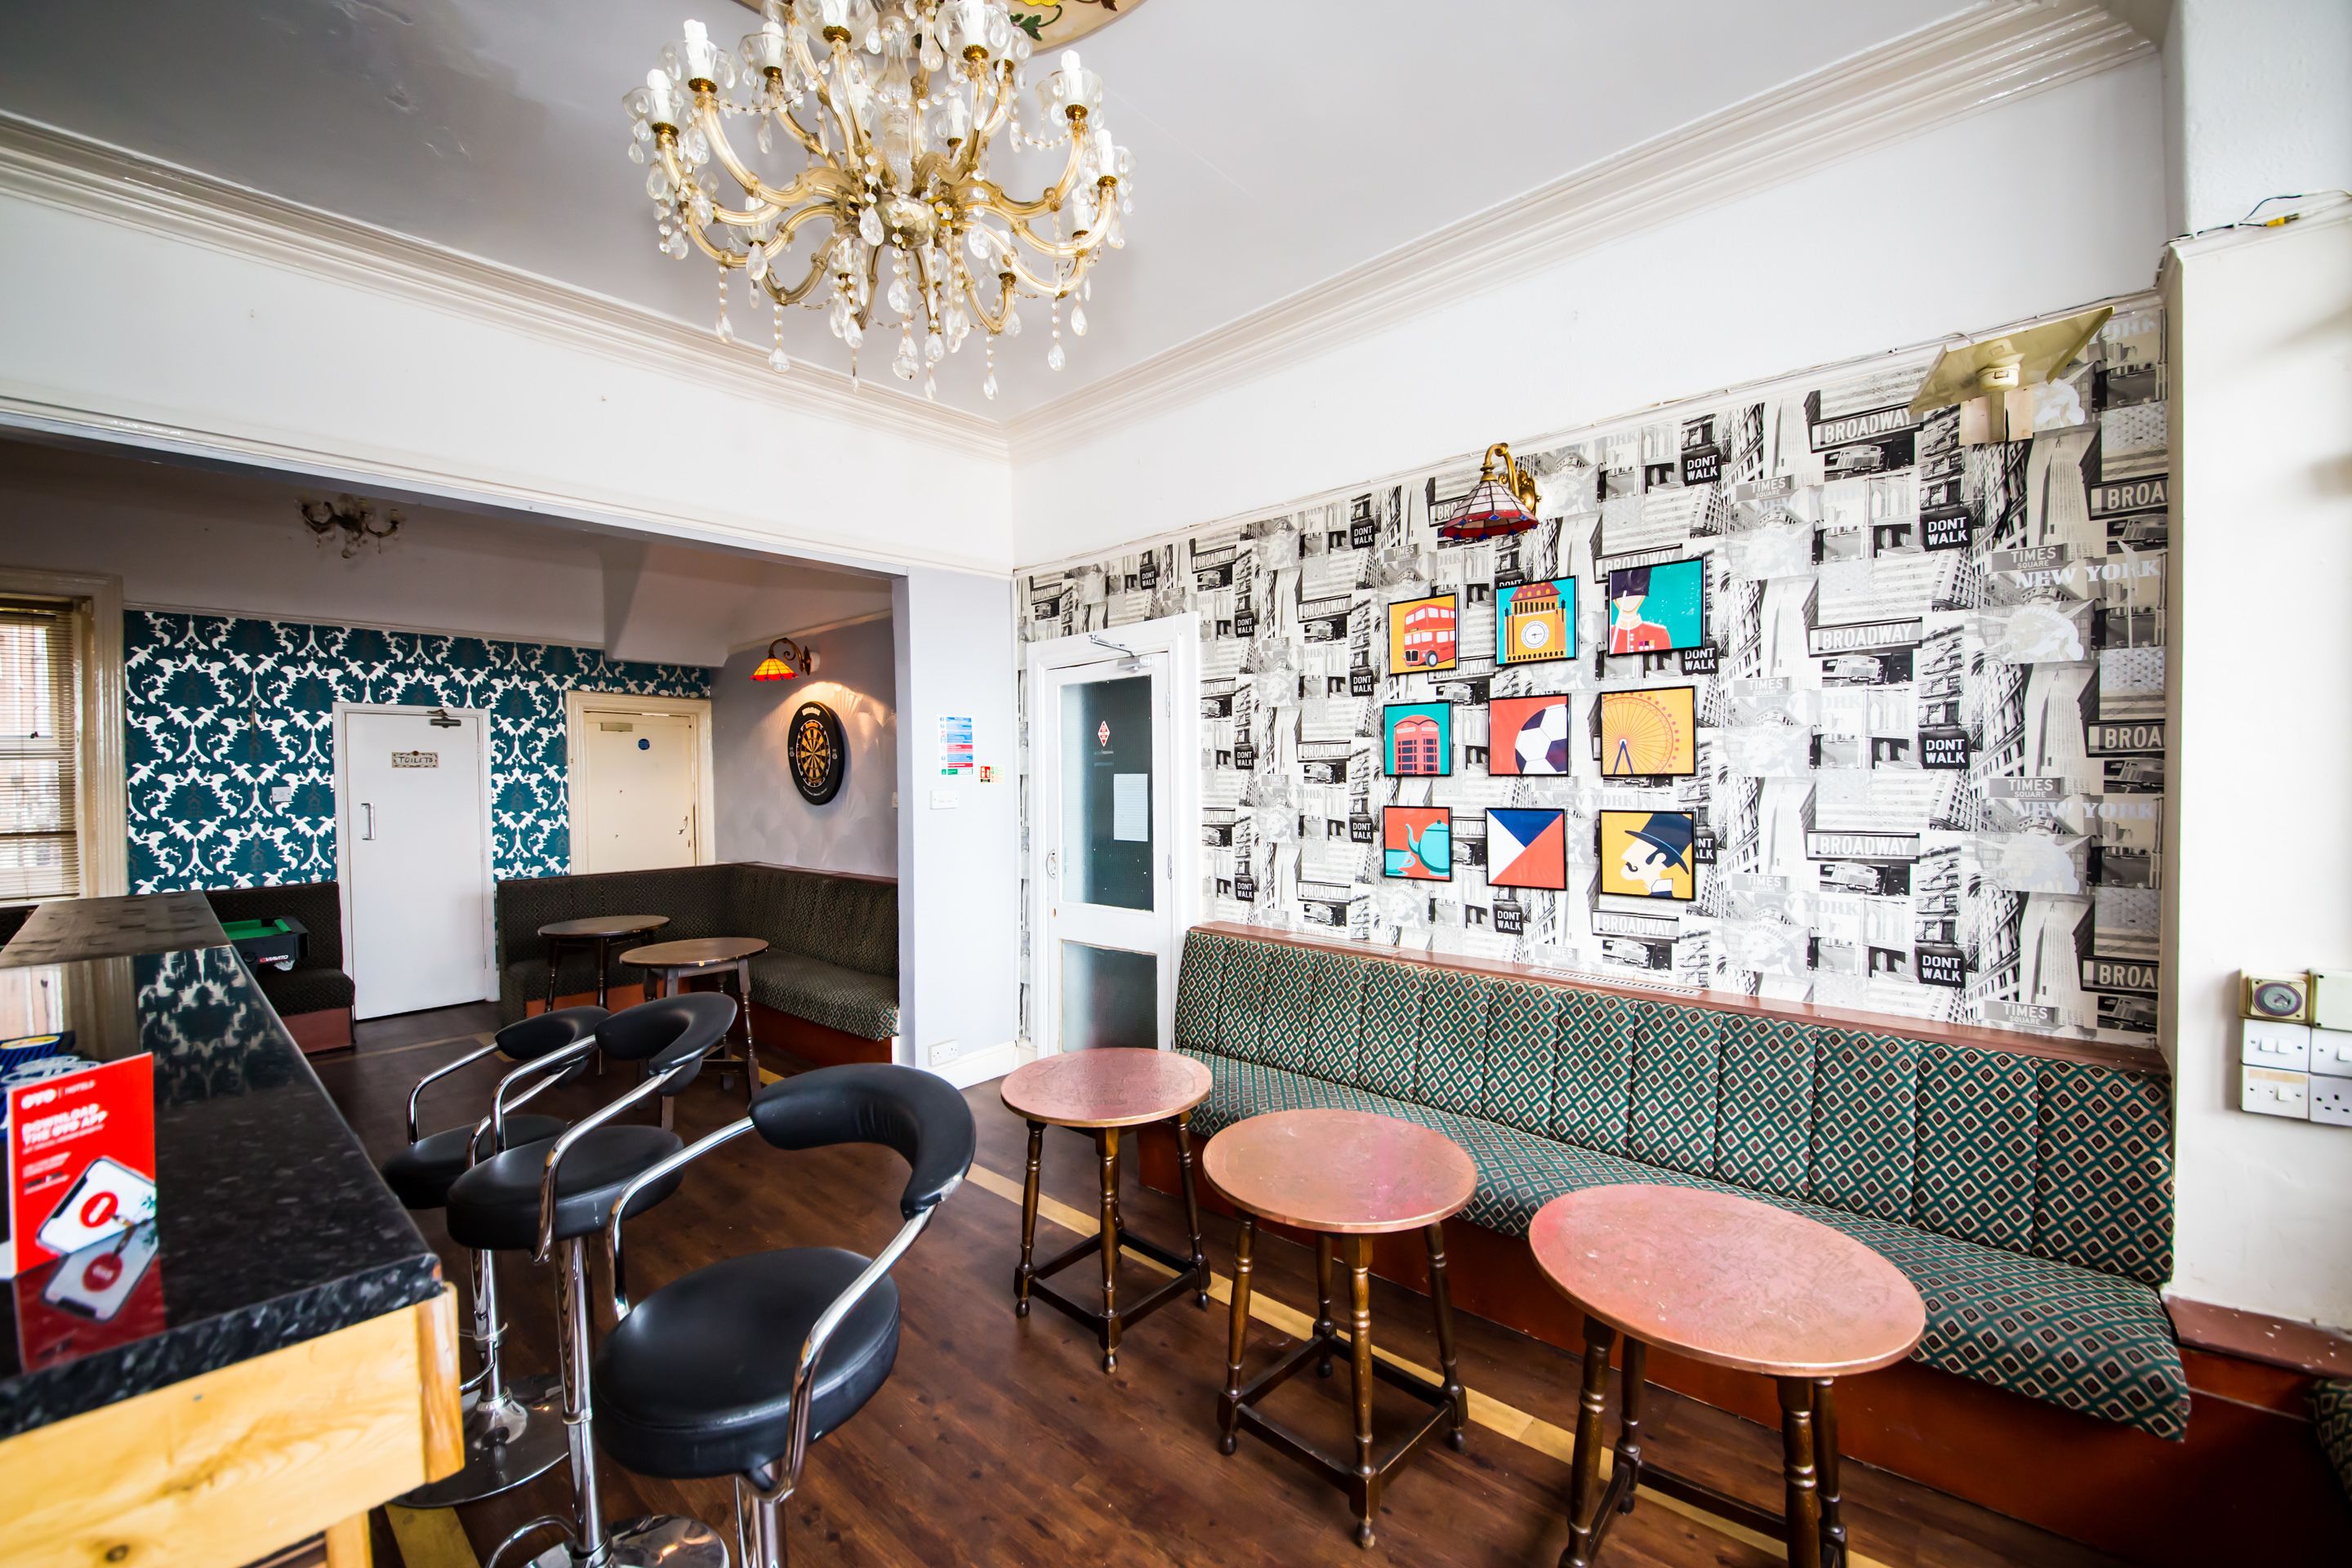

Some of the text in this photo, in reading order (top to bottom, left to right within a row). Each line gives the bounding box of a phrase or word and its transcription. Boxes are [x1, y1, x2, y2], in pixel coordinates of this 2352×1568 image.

[1824, 408, 1912, 443] BROADWAY
[1686, 454, 1717, 471] DONT
[1686, 466, 1718, 482] WALK
[1750, 477, 1786, 493] TIMES
[1756, 489, 1780, 499] SQUARE
[2107, 480, 2167, 510] BROA
[1927, 517, 1967, 532] DONT
[1354, 526, 1373, 537] DONT
[1927, 529, 1968, 546] WALK
[1354, 535, 1374, 546] WALK
[1392, 545, 1415, 558] TIMES
[2011, 547, 2056, 564] TIMES
[1196, 548, 1233, 568] BROADWAY
[1605, 549, 1676, 572] BROADWAY
[2017, 559, 2049, 569] SQUARE
[1142, 572, 1154, 580] DONT
[2015, 559, 2161, 589] NEW YORK
[1142, 577, 1156, 586] WALK
[1304, 598, 1348, 618] BROADWAY
[1237, 617, 1253, 627] DONT
[1237, 625, 1254, 635] WALK
[1268, 638, 1286, 647] TIMES
[1822, 623, 1913, 650] BROADWAY
[1685, 648, 1715, 660] DONT
[1685, 659, 1716, 670] WALK
[1353, 675, 1371, 684] DONT
[1748, 679, 1784, 690] TIMES
[1200, 681, 1232, 696] ROADWAY
[1353, 683, 1372, 693] WALK
[2105, 726, 2163, 749] BROA
[1926, 739, 1965, 751] DONT
[1236, 751, 1253, 759] DONT
[1303, 744, 1348, 759] BROADWAY
[1926, 751, 1966, 764] WALK
[1237, 758, 1253, 767] WALK
[1547, 777, 1574, 786] TIMES
[2007, 779, 2054, 791] TIMES
[2015, 801, 2155, 819] NEW YORK
[1352, 822, 1371, 831] DONT
[1352, 831, 1372, 840] WALK
[1698, 838, 1713, 849] NT
[1820, 836, 1911, 856] BROADWAY
[1695, 849, 1714, 859] ALK
[1236, 882, 1253, 891] DONT
[1746, 875, 1781, 887] TIMES
[1237, 889, 1254, 899] WALK
[1303, 885, 1348, 900] BROADWAY
[1497, 910, 1521, 920] DONT
[1497, 920, 1521, 931] WALK
[1602, 915, 1672, 935] BROADWAY
[1922, 955, 1961, 969] DONT
[1922, 968, 1961, 982] WALK
[2099, 964, 2157, 988] BROA
[2002, 1002, 2048, 1019] TIMES
[2008, 1015, 2041, 1025] SQUARE
